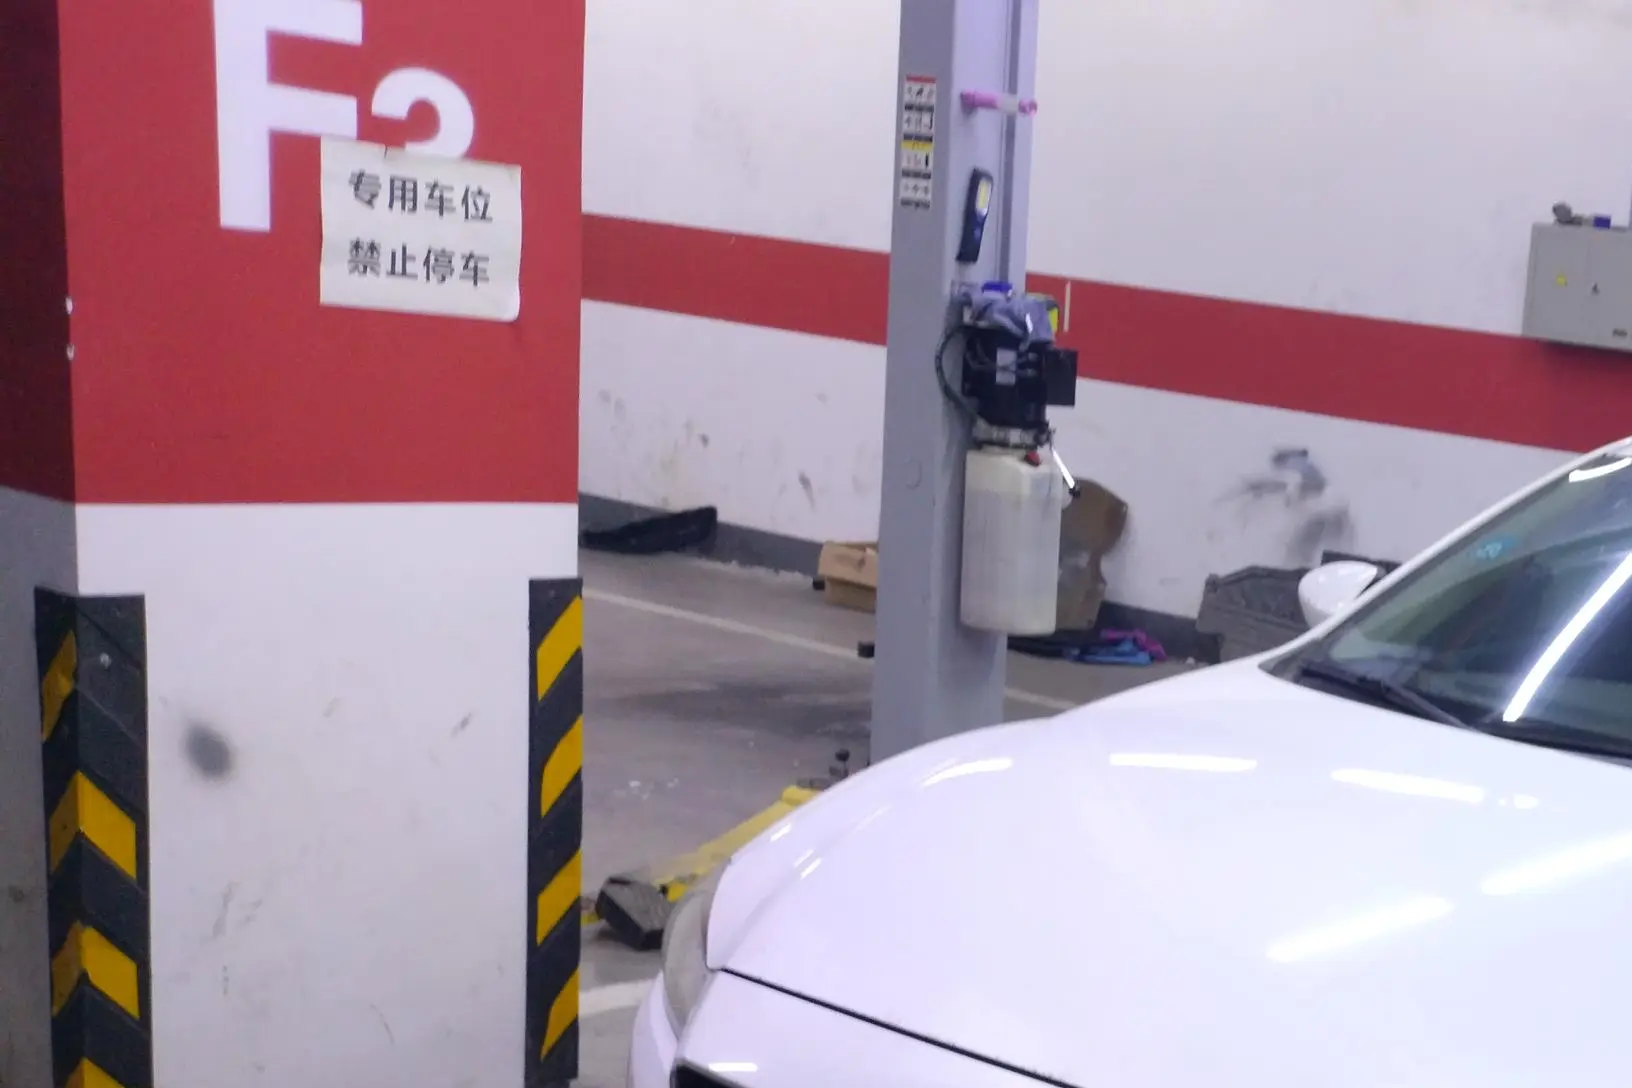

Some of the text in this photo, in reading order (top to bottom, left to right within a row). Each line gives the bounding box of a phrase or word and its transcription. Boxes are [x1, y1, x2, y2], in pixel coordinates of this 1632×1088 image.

[349, 169, 493, 222] 专用车位
[348, 237, 490, 288] 禁止停车
